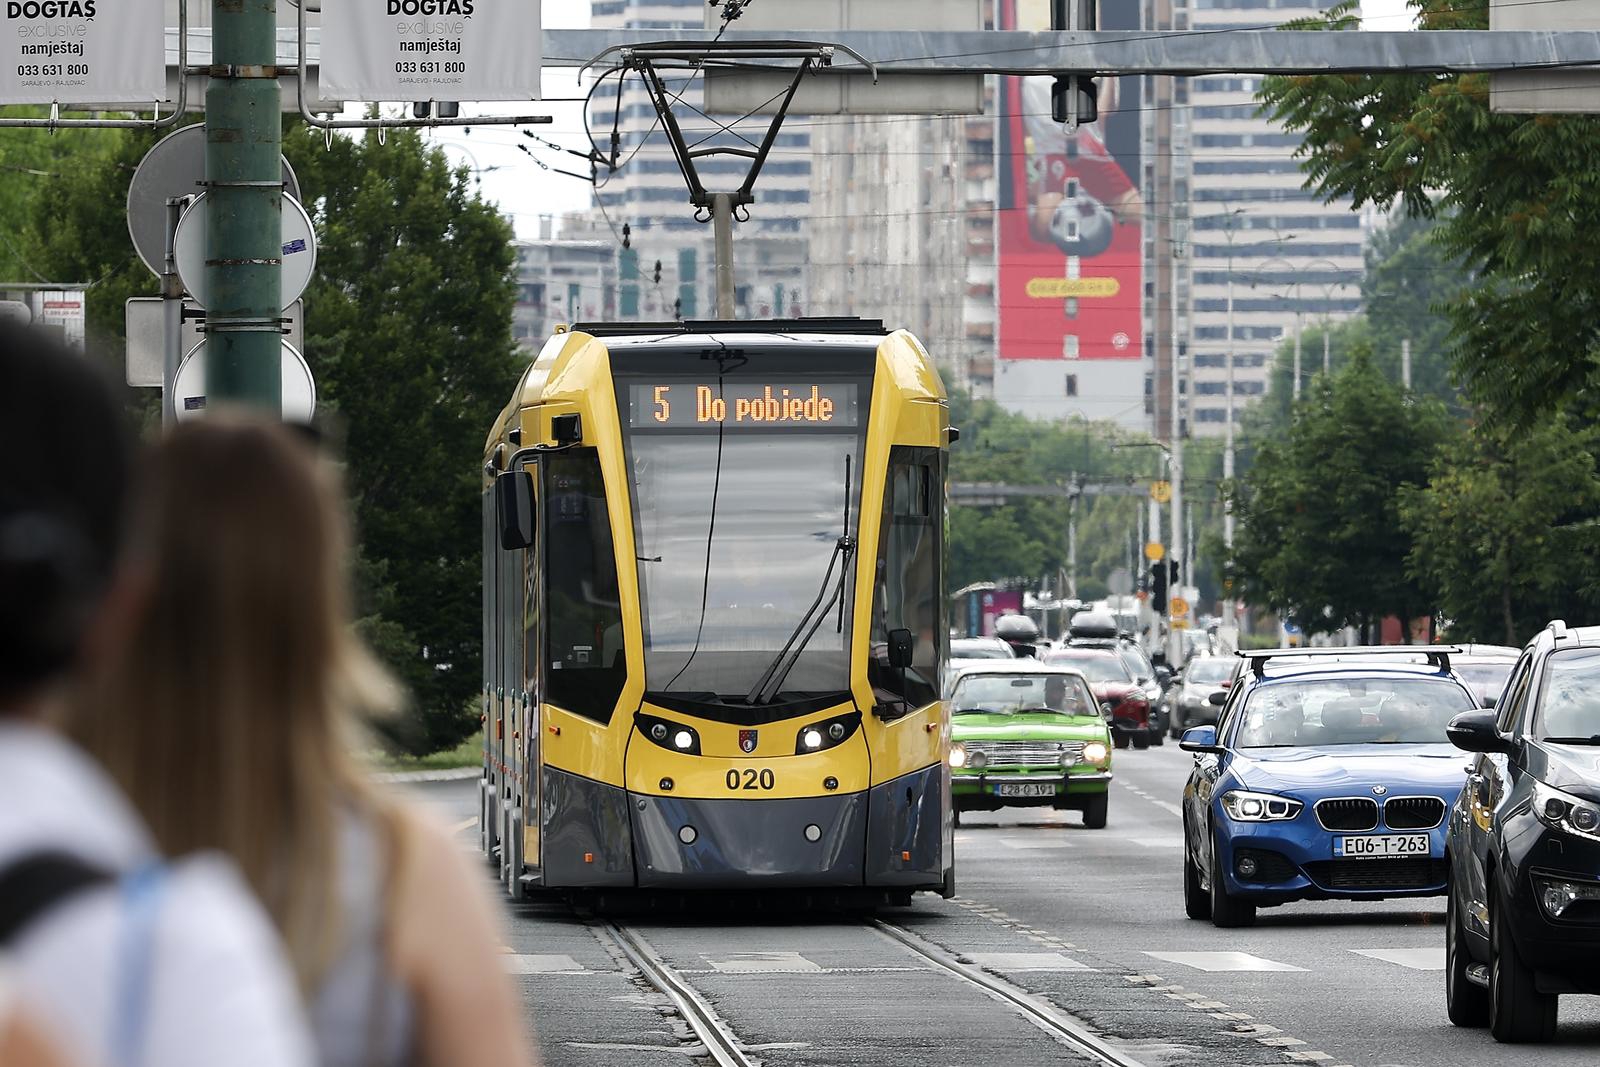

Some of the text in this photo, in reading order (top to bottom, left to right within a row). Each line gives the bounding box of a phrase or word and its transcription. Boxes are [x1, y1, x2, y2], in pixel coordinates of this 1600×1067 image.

[18, 21, 87, 38] exclusive
[396, 19, 464, 34] exclusive
[21, 40, 84, 57] namještaj
[400, 38, 461, 54] namještaj
[18, 64, 89, 76] 033 631 800
[395, 62, 466, 73] 033 631 800
[653, 384, 834, 423] 5 Do pobjede
[726, 768, 775, 790] 020
[1345, 836, 1427, 854] E06-T-263
